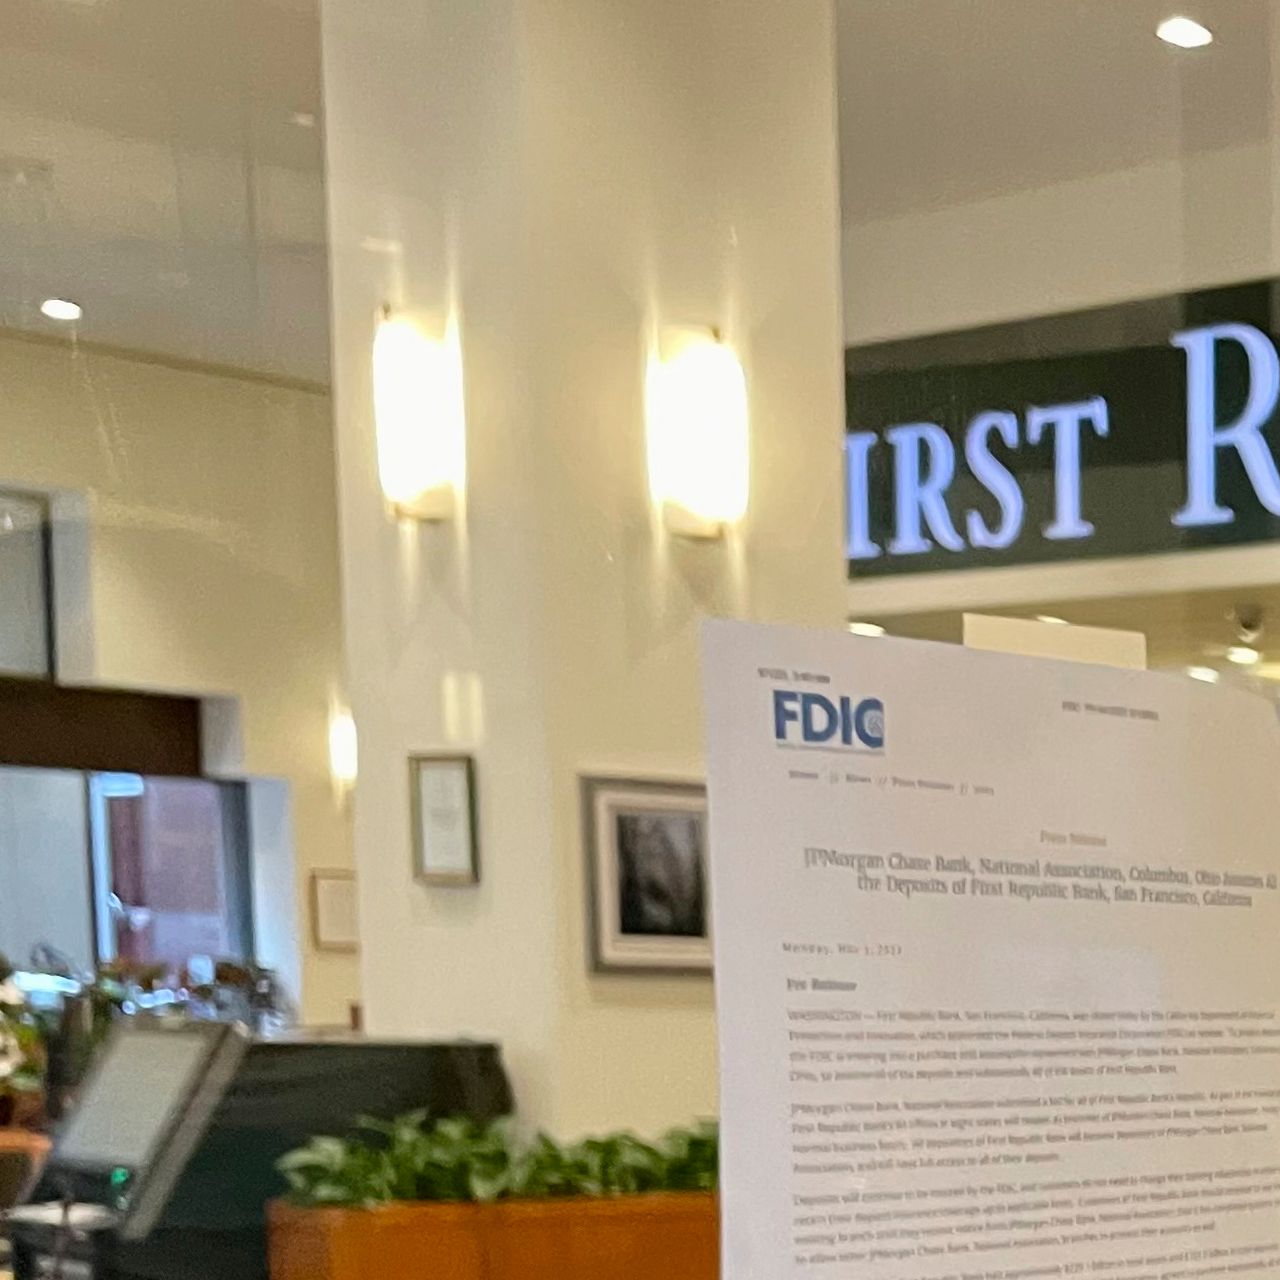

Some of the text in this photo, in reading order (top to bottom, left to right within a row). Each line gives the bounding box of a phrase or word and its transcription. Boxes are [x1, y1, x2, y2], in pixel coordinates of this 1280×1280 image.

[845, 394, 1109, 561] IRST
[773, 689, 884, 749] FDIC
[803, 847, 885, 870] JPMorgan
[888, 851, 931, 871] Chase
[979, 857, 1040, 877] National
[857, 873, 881, 891] the
[886, 875, 948, 899] Deposits
[952, 877, 968, 896] of
[971, 878, 1003, 897] First
[1008, 881, 1068, 902] Republic
[1113, 885, 1137, 902] San
